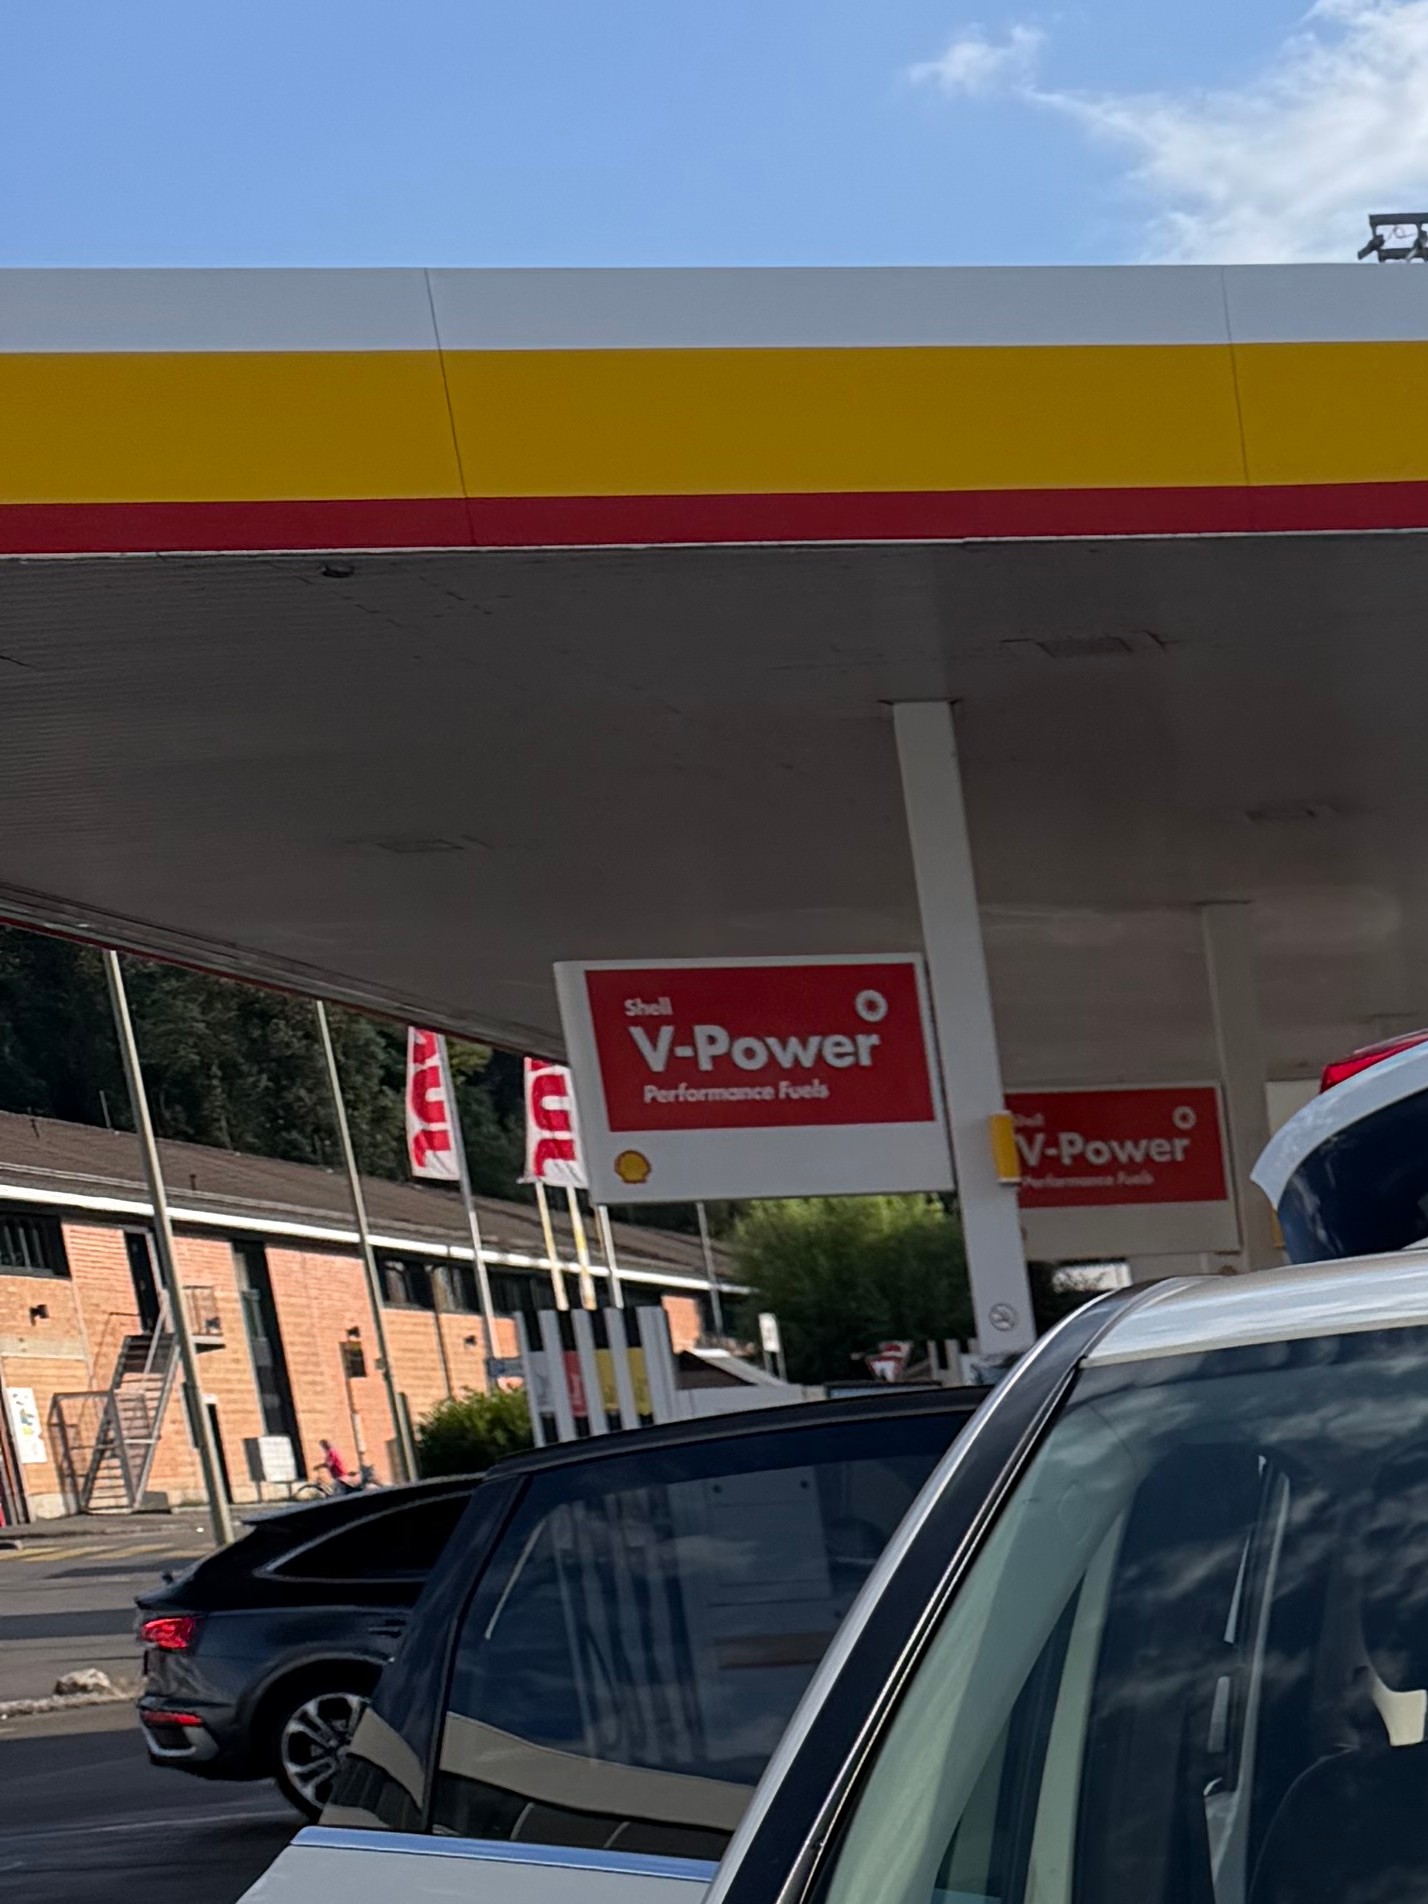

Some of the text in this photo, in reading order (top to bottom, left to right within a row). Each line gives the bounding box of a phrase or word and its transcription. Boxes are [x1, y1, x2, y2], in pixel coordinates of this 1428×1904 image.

[624, 996, 673, 1017] Shell
[628, 1024, 881, 1073] V-Power
[643, 1078, 830, 1104] Performance Fuels
[1015, 1131, 1191, 1167] V-Power
